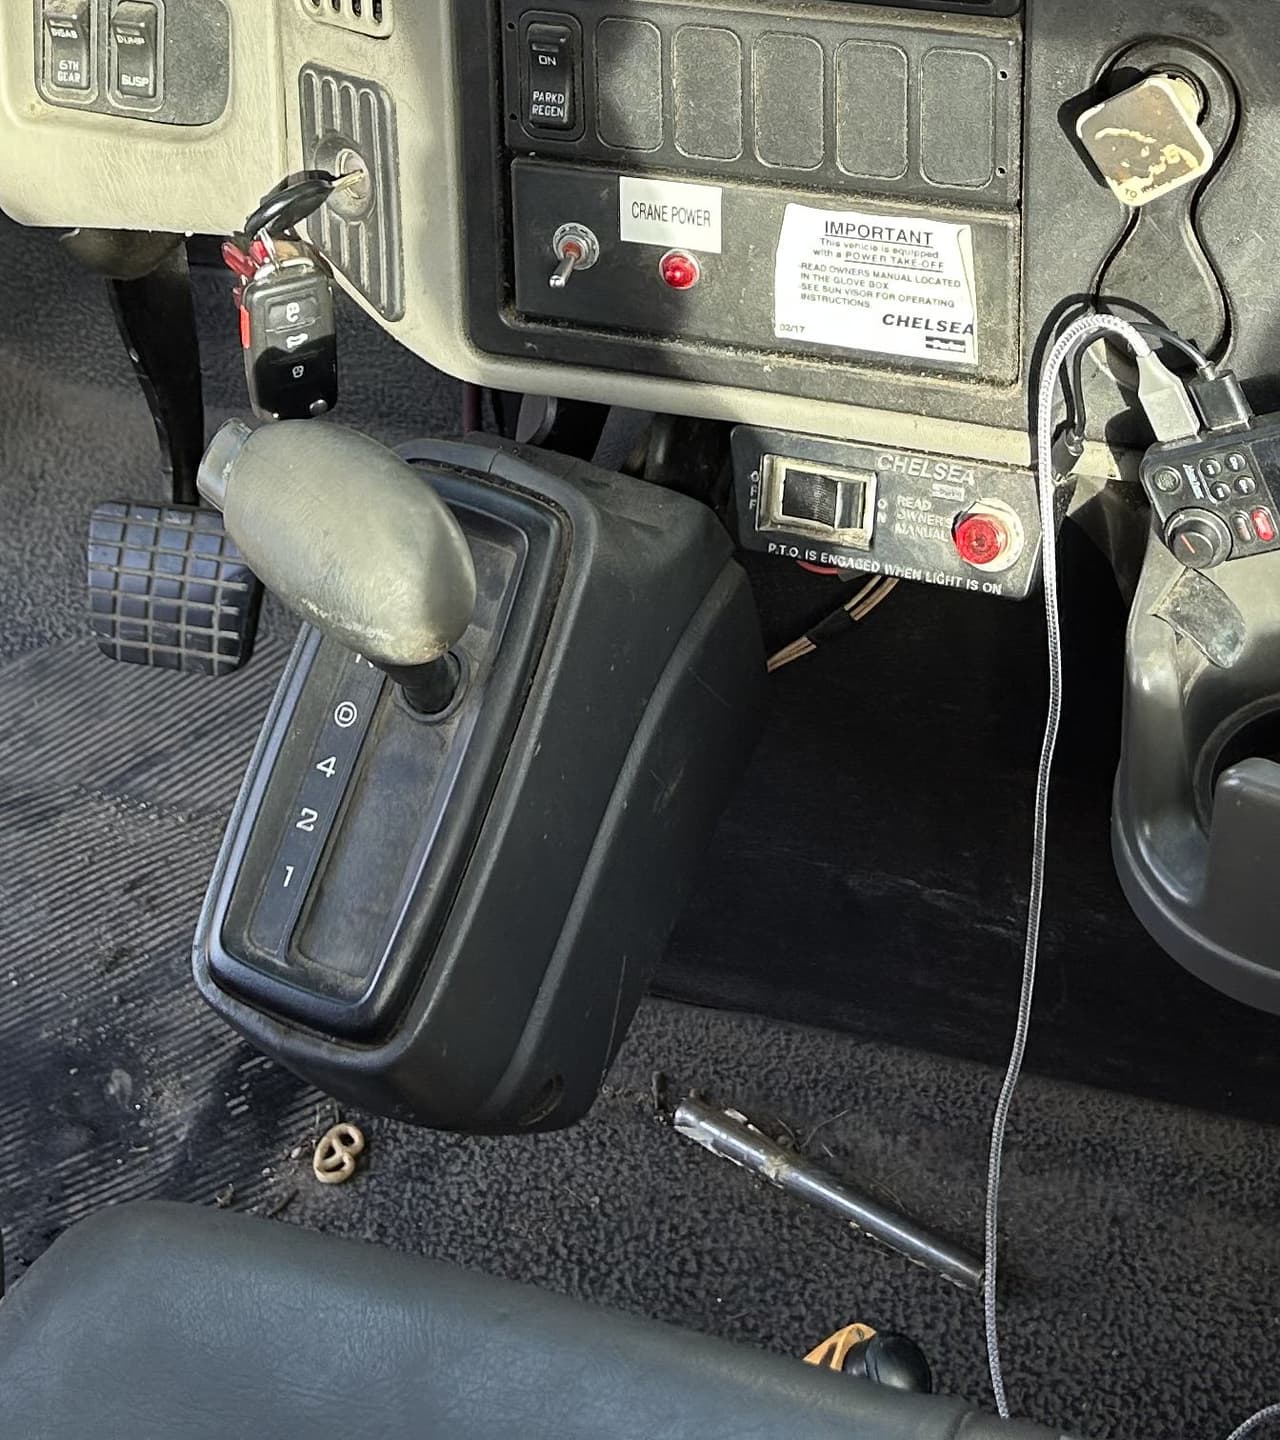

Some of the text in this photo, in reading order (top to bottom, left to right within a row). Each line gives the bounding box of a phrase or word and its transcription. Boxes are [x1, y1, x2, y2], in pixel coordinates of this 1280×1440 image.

[59, 60, 79, 71] 6TH
[538, 55, 557, 66] ON
[57, 70, 81, 83] GEAR
[533, 91, 565, 104] PARKD
[532, 104, 564, 118] REGEN
[631, 201, 711, 227] CRANE POWER
[824, 220, 933, 246] IMPORTANT
[820, 238, 939, 259] This vehicle is equipped
[813, 249, 833, 258] with
[845, 252, 887, 264] POWER
[891, 256, 944, 270] TAKE-OFF
[801, 272, 889, 290] IN THE GLOVE BOX
[829, 265, 870, 278] OWNERS
[872, 270, 913, 283] MANUAL
[915, 275, 961, 288] LOCATED
[801, 293, 870, 308] INSTRUCTIONS
[822, 285, 842, 295] SUN
[844, 287, 874, 298] VISOR
[875, 291, 895, 301] FOR
[898, 294, 955, 308] OPERATING
[882, 314, 975, 336] CHELSEA
[877, 455, 976, 486] CHELSEA
[876, 499, 888, 524] ON
[897, 495, 932, 511] READ
[894, 525, 949, 543] MANUAL
[805, 549, 818, 561] IS
[820, 551, 881, 574] ENGAGED
[884, 561, 922, 581] WHEN
[925, 571, 963, 589] LIGHT
[966, 577, 979, 591] IS
[982, 581, 1003, 596] ON
[316, 756, 337, 778] 4
[295, 807, 318, 832] 2
[282, 866, 295, 888] 1
